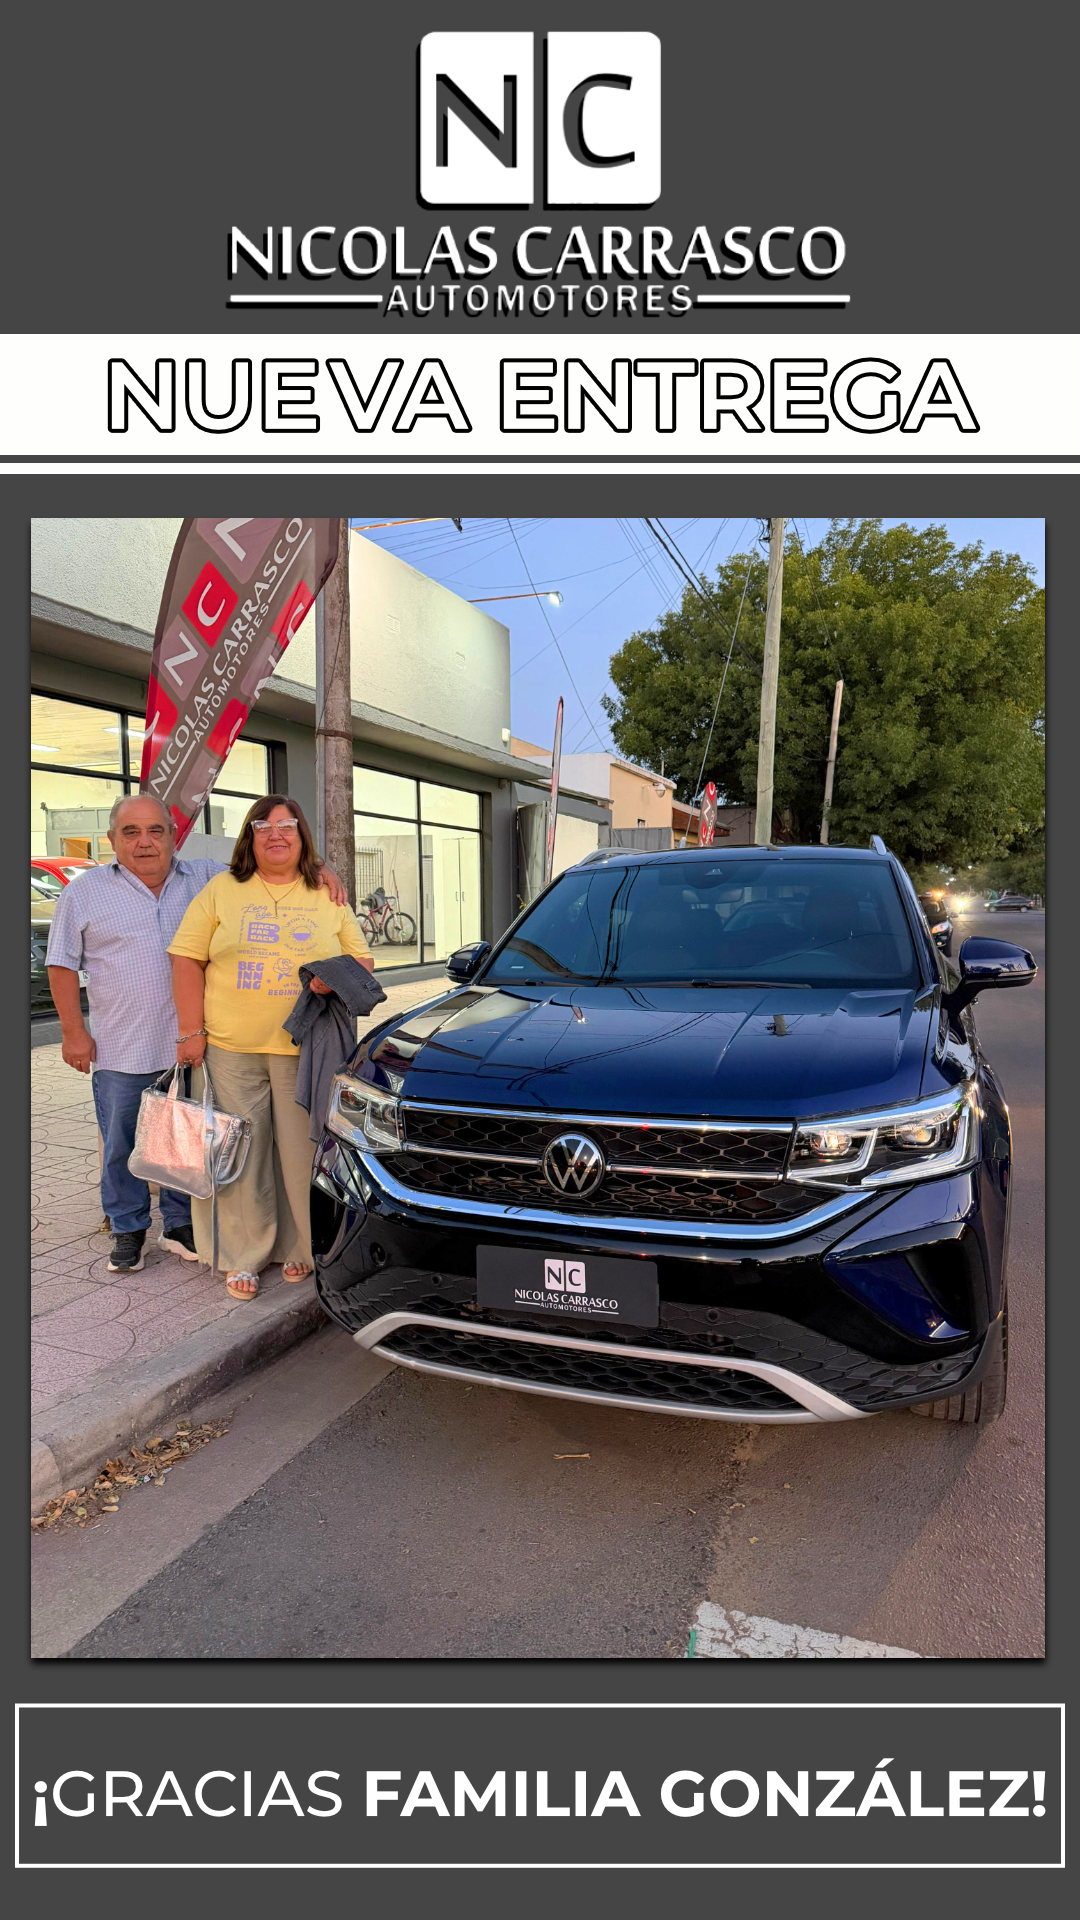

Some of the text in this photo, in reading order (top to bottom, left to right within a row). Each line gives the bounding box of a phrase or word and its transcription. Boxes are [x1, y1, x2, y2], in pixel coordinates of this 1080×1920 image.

[151, 518, 303, 794] NICOLAS CARRASCO
[194, 603, 270, 743] AUTOMOTORES
[238, 961, 264, 971] BEG
[237, 971, 263, 980] INN
[236, 980, 262, 990] ING
[514, 1288, 618, 1310] NICOLAS CARRASCO
[539, 1302, 592, 1314] AUTOMOTORES
